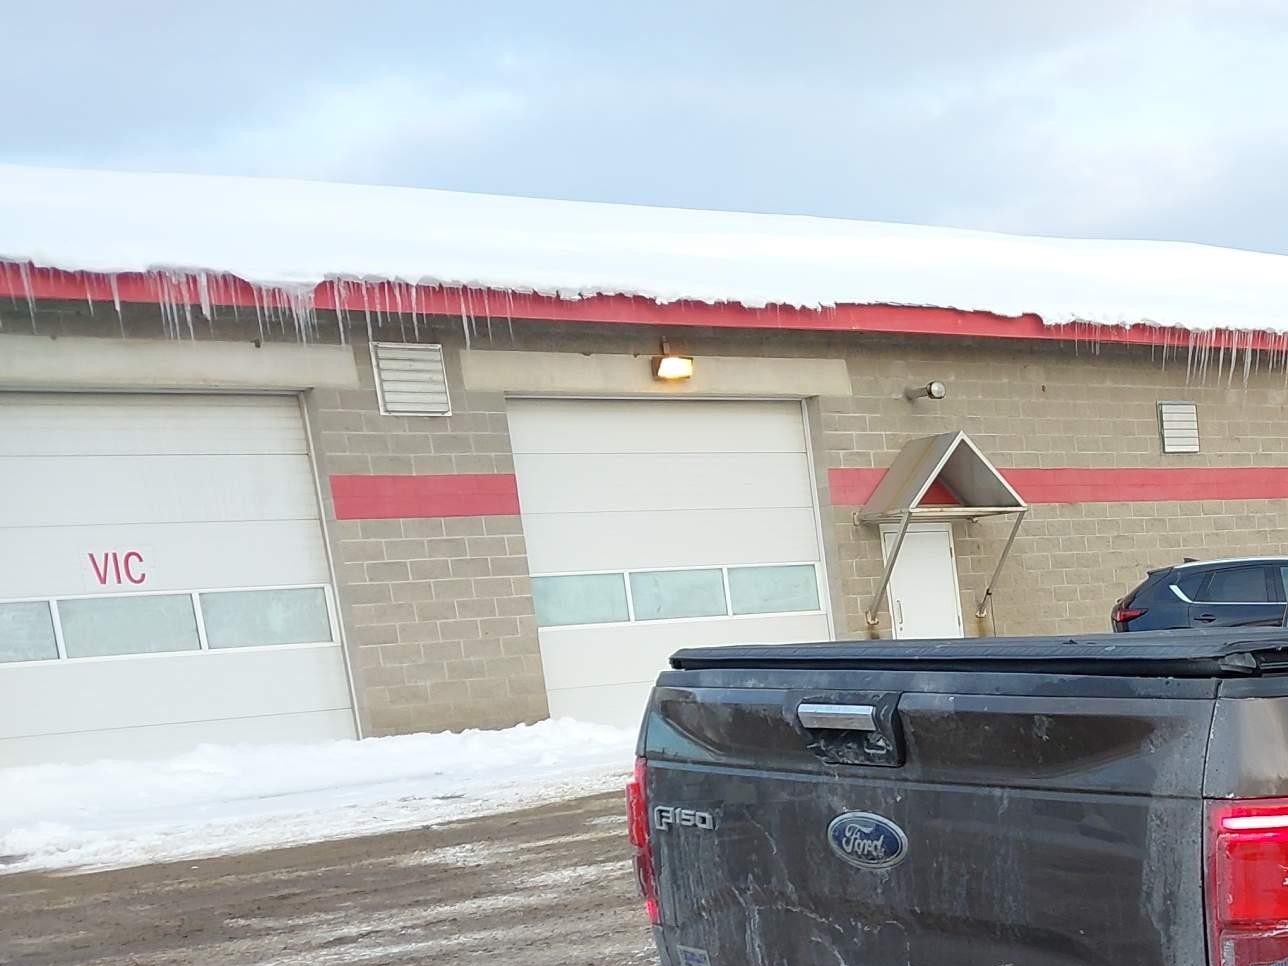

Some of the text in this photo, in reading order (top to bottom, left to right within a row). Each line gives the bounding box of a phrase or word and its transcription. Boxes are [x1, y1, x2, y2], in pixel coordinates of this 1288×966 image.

[88, 550, 147, 585] VIC
[654, 805, 713, 831] F150
[841, 823, 886, 858] Ford
